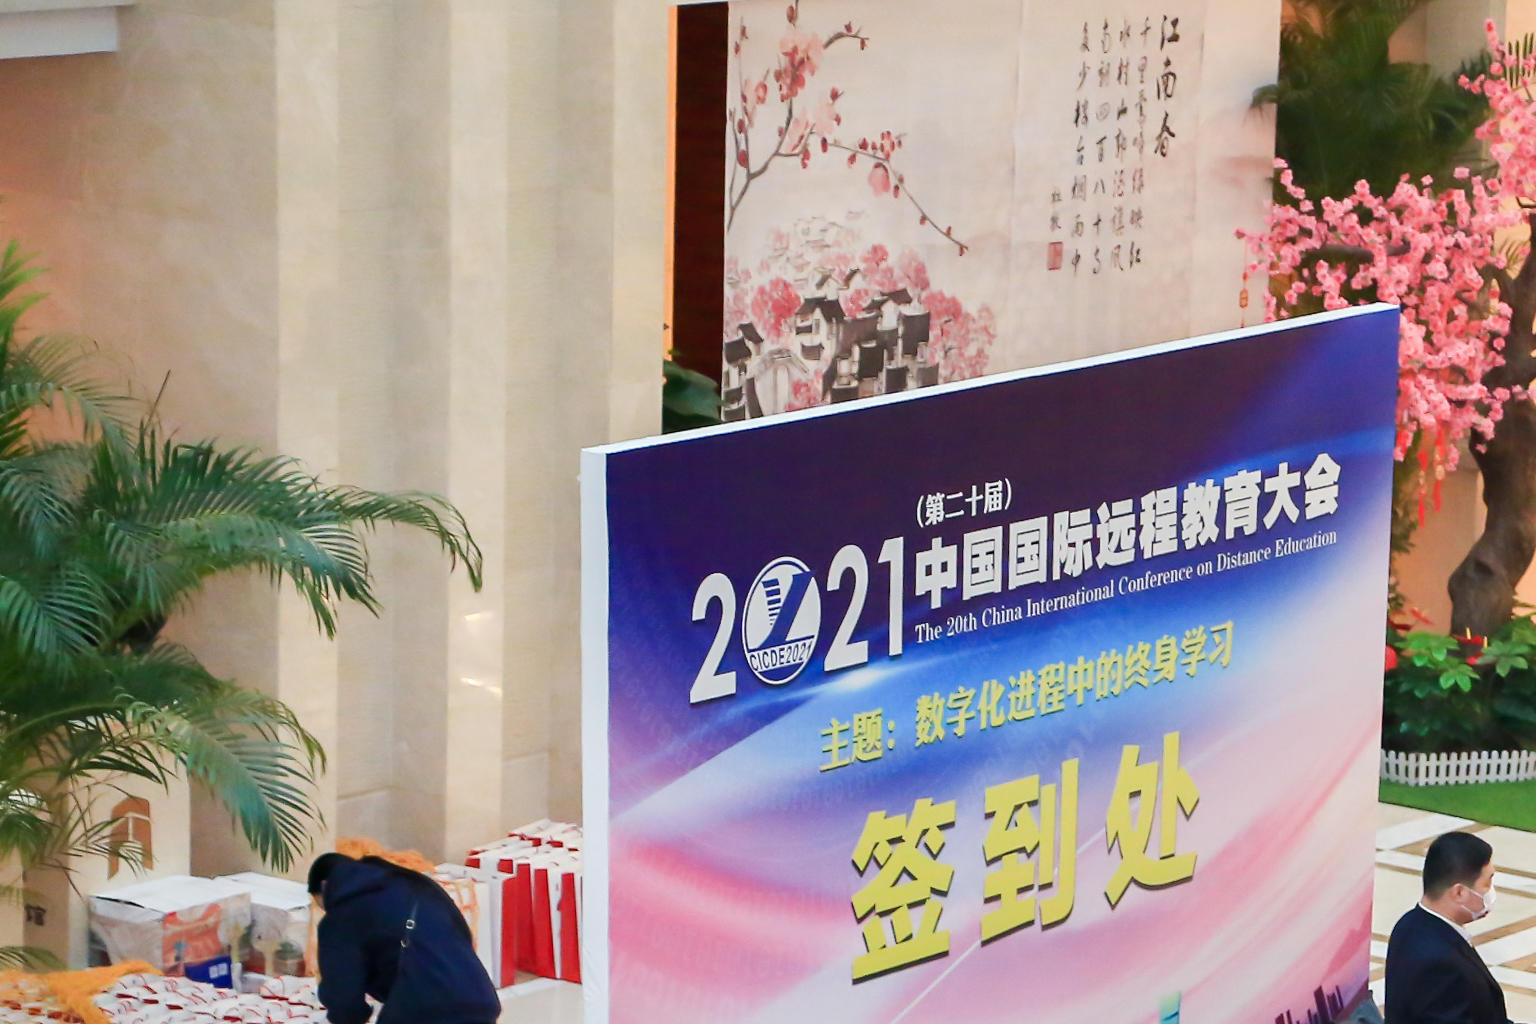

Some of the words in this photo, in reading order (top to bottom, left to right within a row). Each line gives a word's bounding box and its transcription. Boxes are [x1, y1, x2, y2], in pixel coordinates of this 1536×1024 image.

[915, 452, 1341, 610] 中国国际远程教育大会
[915, 621, 942, 644] The
[946, 612, 977, 637] 20th
[981, 604, 1023, 628] China
[1026, 580, 1114, 617] International
[1118, 565, 1193, 595] Conference
[1196, 559, 1213, 577] on
[1217, 545, 1272, 572] Distance
[1275, 529, 1337, 558] Education
[749, 641, 813, 672] CICDE2021
[850, 731, 1200, 983] 签到处
